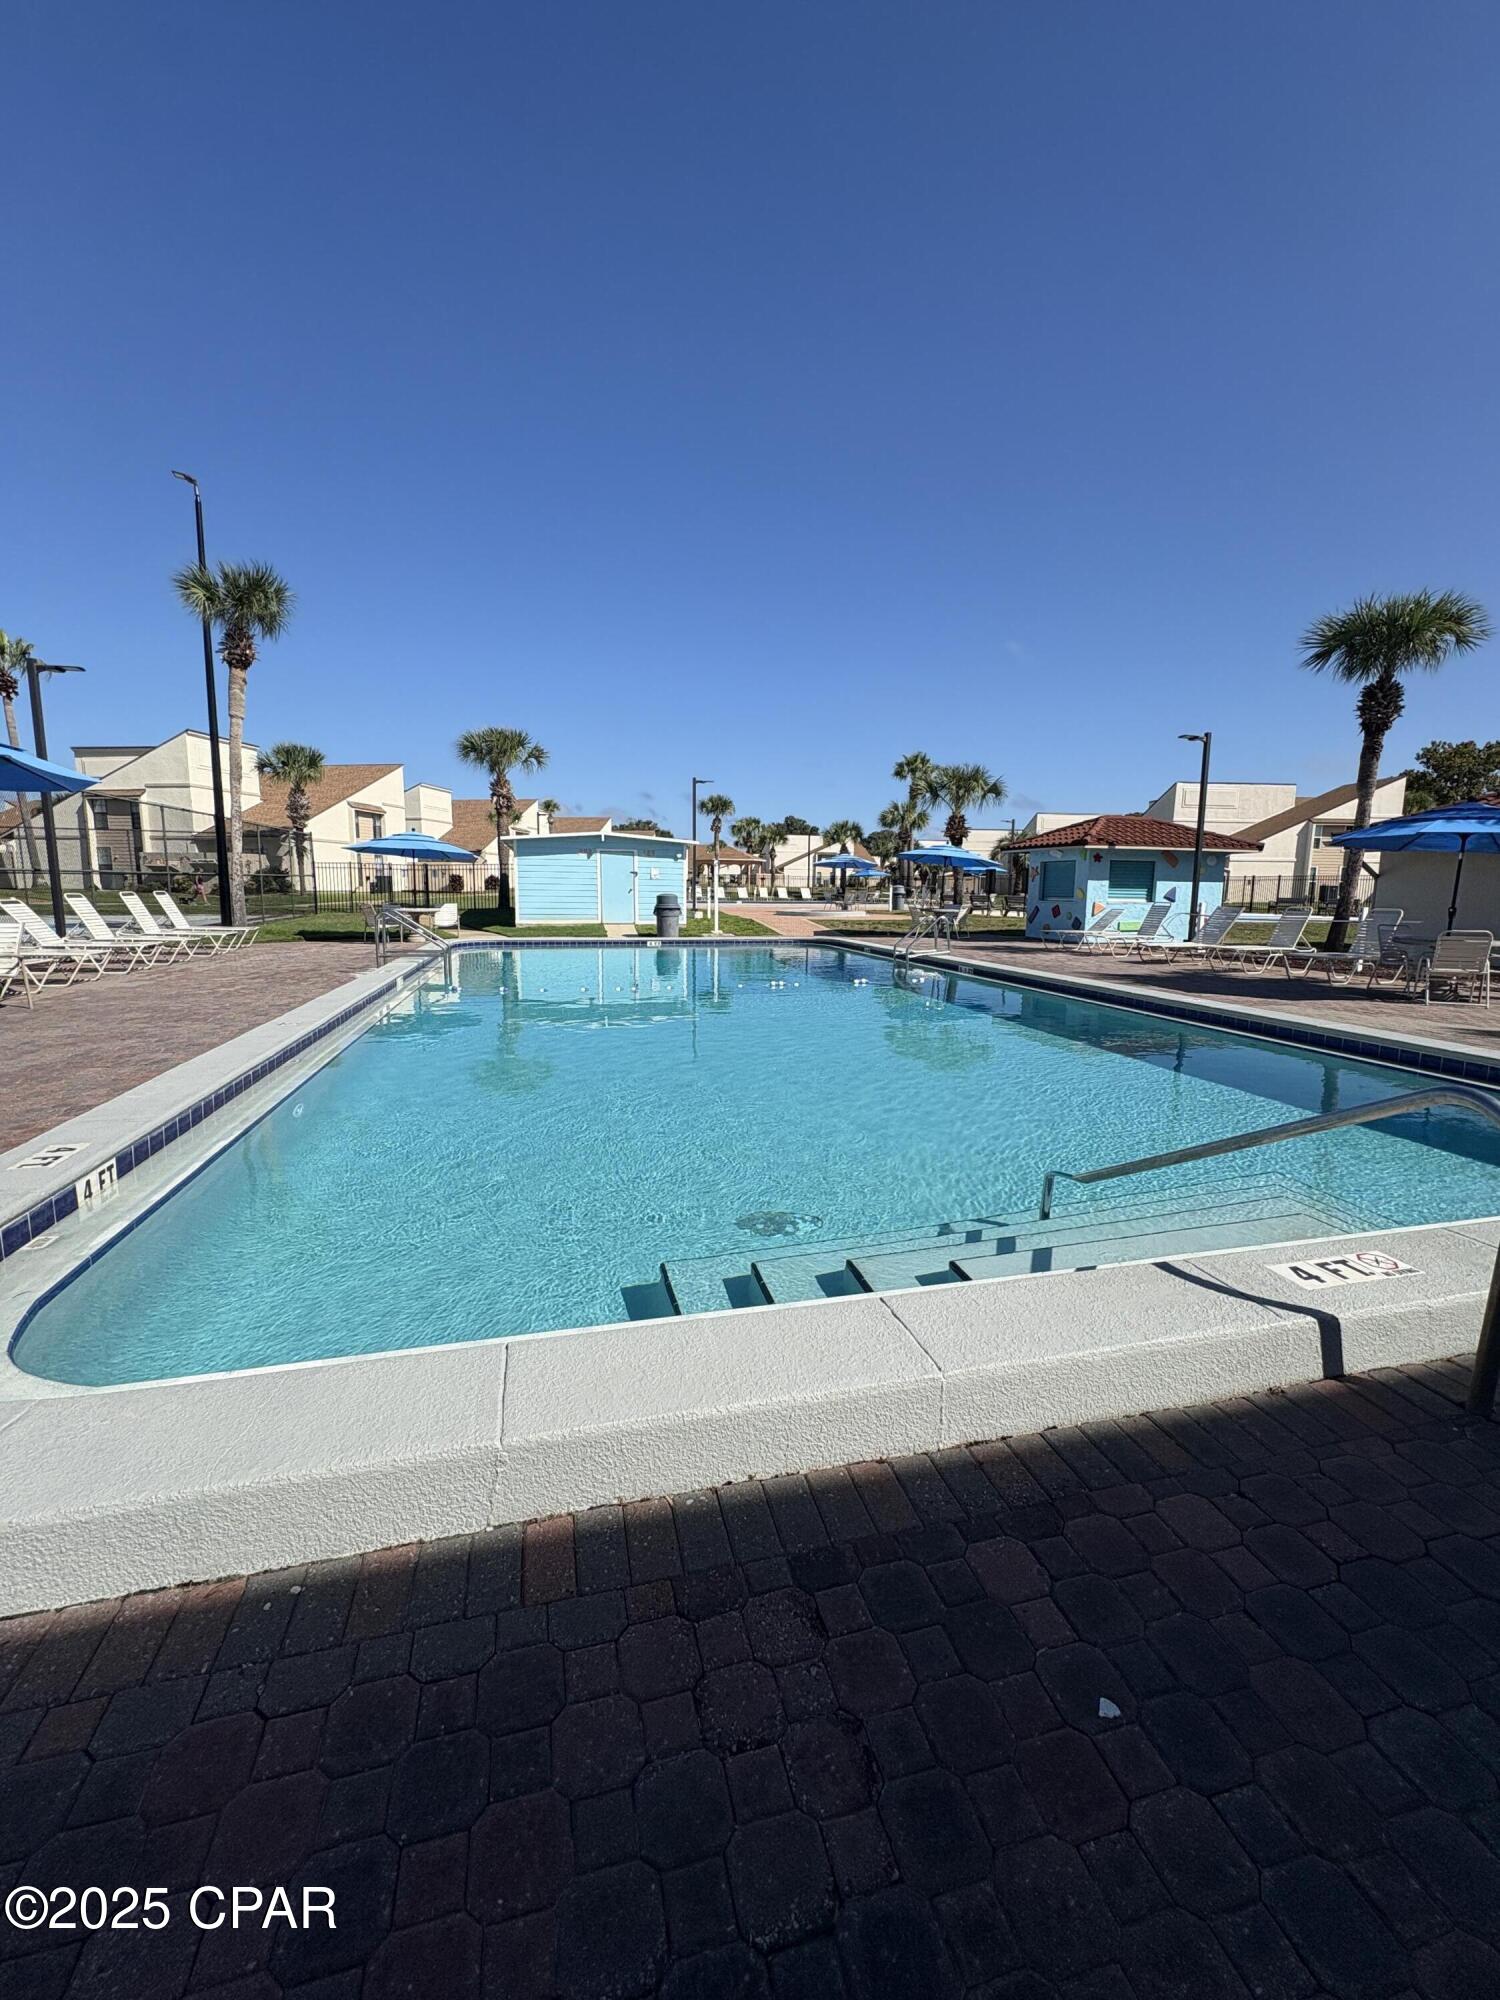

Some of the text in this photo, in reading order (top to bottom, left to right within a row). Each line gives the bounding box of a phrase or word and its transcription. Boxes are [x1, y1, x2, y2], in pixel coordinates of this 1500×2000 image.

[84, 1163, 114, 1200] 4 FT
[1288, 1266, 1327, 1283] 4
